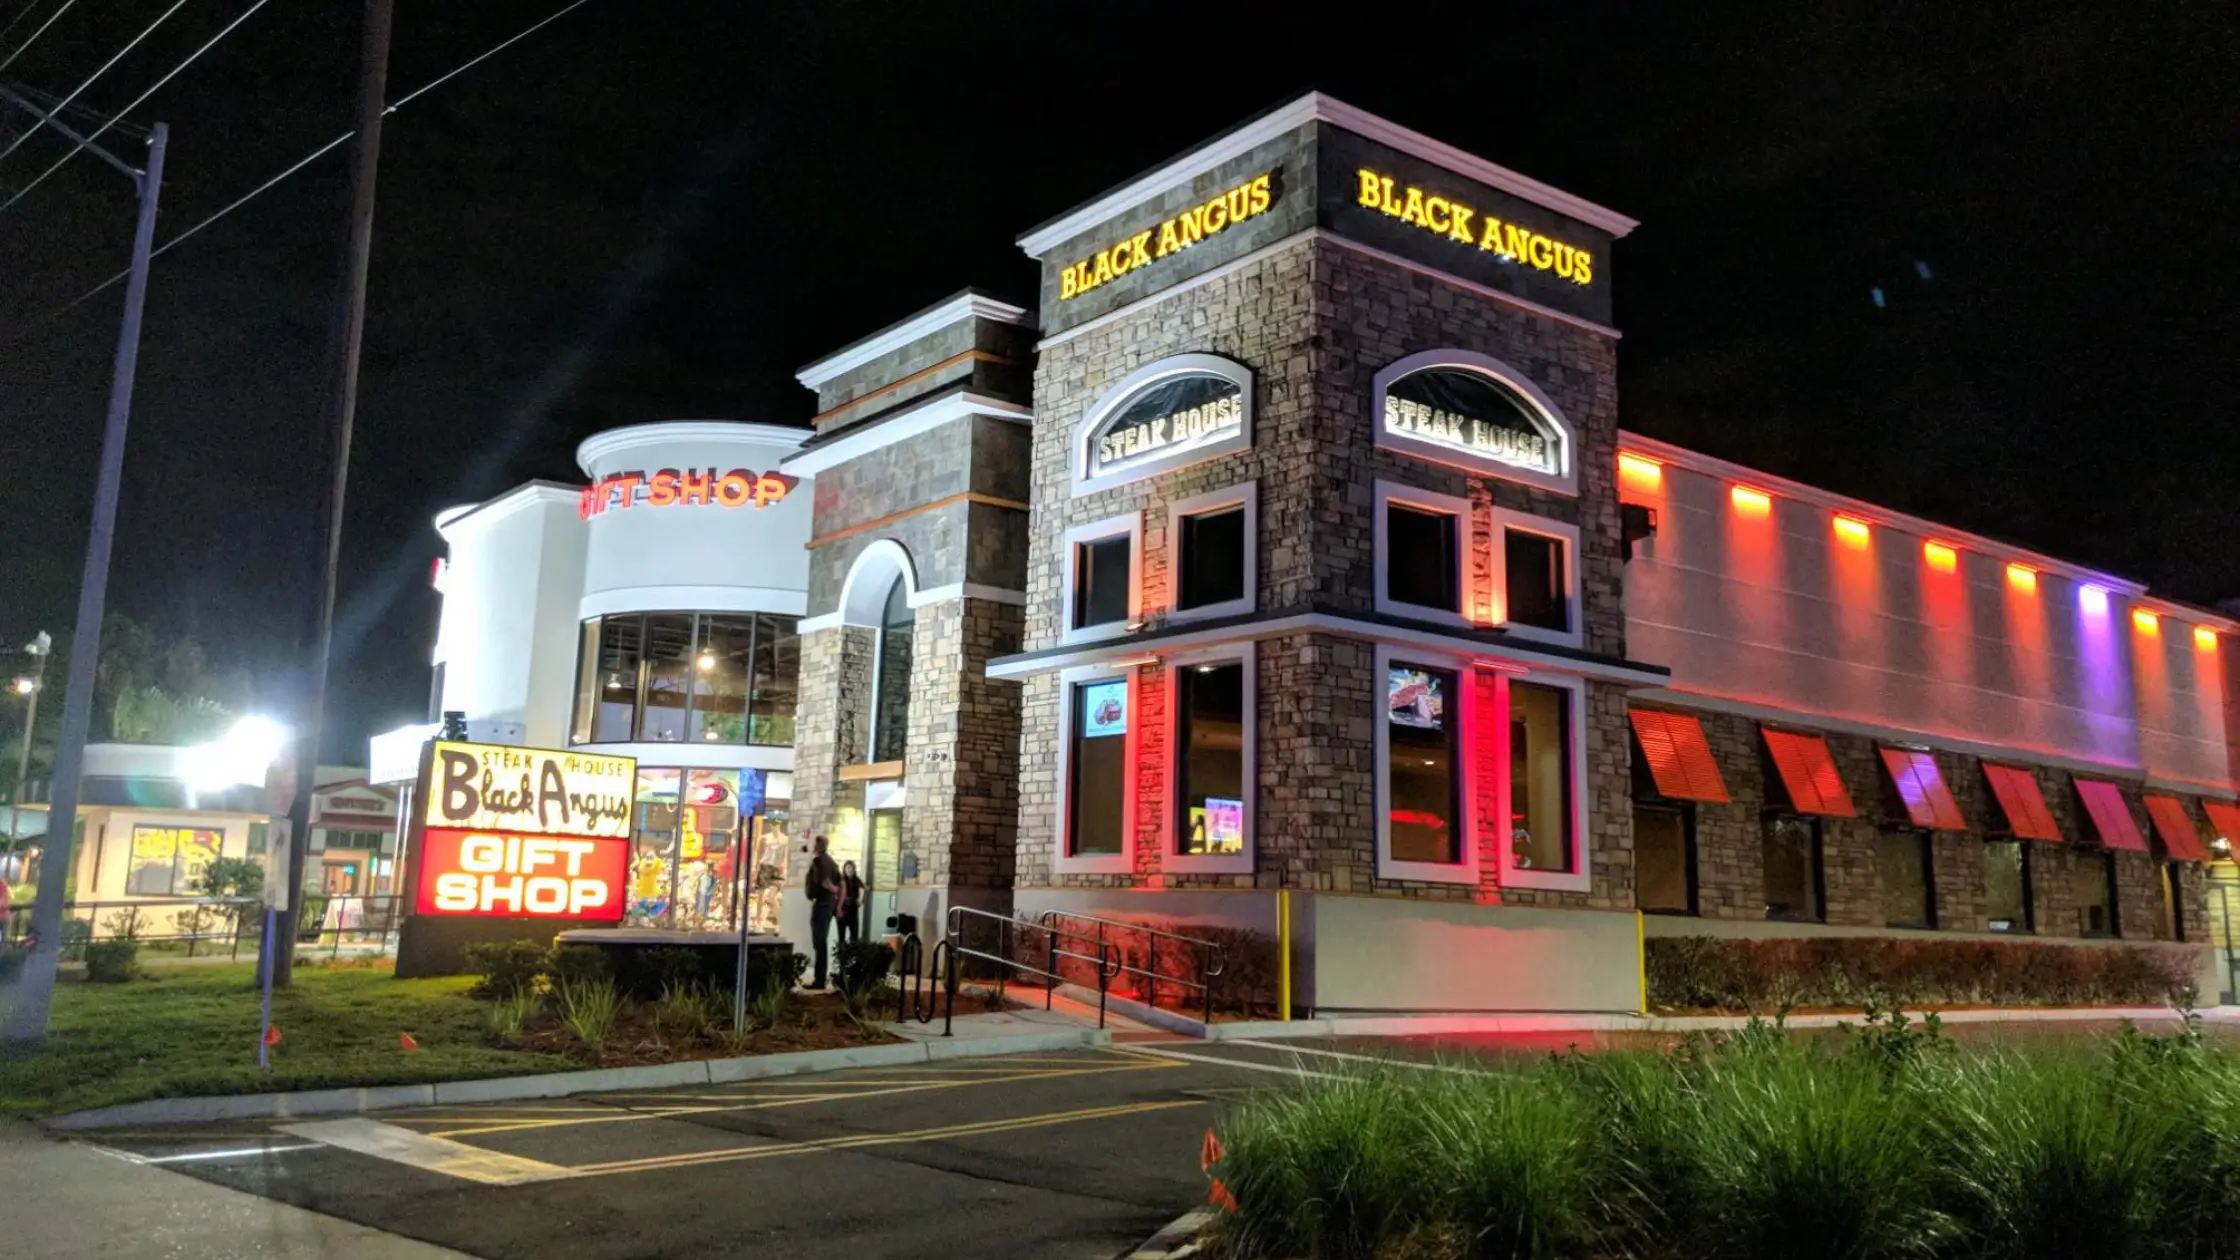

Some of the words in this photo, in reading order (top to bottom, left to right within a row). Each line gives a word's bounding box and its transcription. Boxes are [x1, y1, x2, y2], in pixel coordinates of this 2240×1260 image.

[1060, 229, 1153, 301] BLACK
[1156, 174, 1271, 257] ANGUS
[1356, 168, 1474, 244] BLACK
[1479, 217, 1594, 285] ANGUS
[1100, 418, 1166, 463] STEAK
[1171, 393, 1241, 443] HOUSE
[1385, 395, 1464, 445] STEAK
[1472, 418, 1545, 466] HOUSE
[578, 476, 640, 521] GIFT
[648, 472, 787, 509] SHOP
[439, 749, 534, 821] Black
[538, 759, 628, 831] Angus
[482, 751, 533, 770] STEAK
[571, 759, 624, 776] HOUSE
[459, 835, 596, 876] GIFT
[434, 873, 608, 915] SHOP
